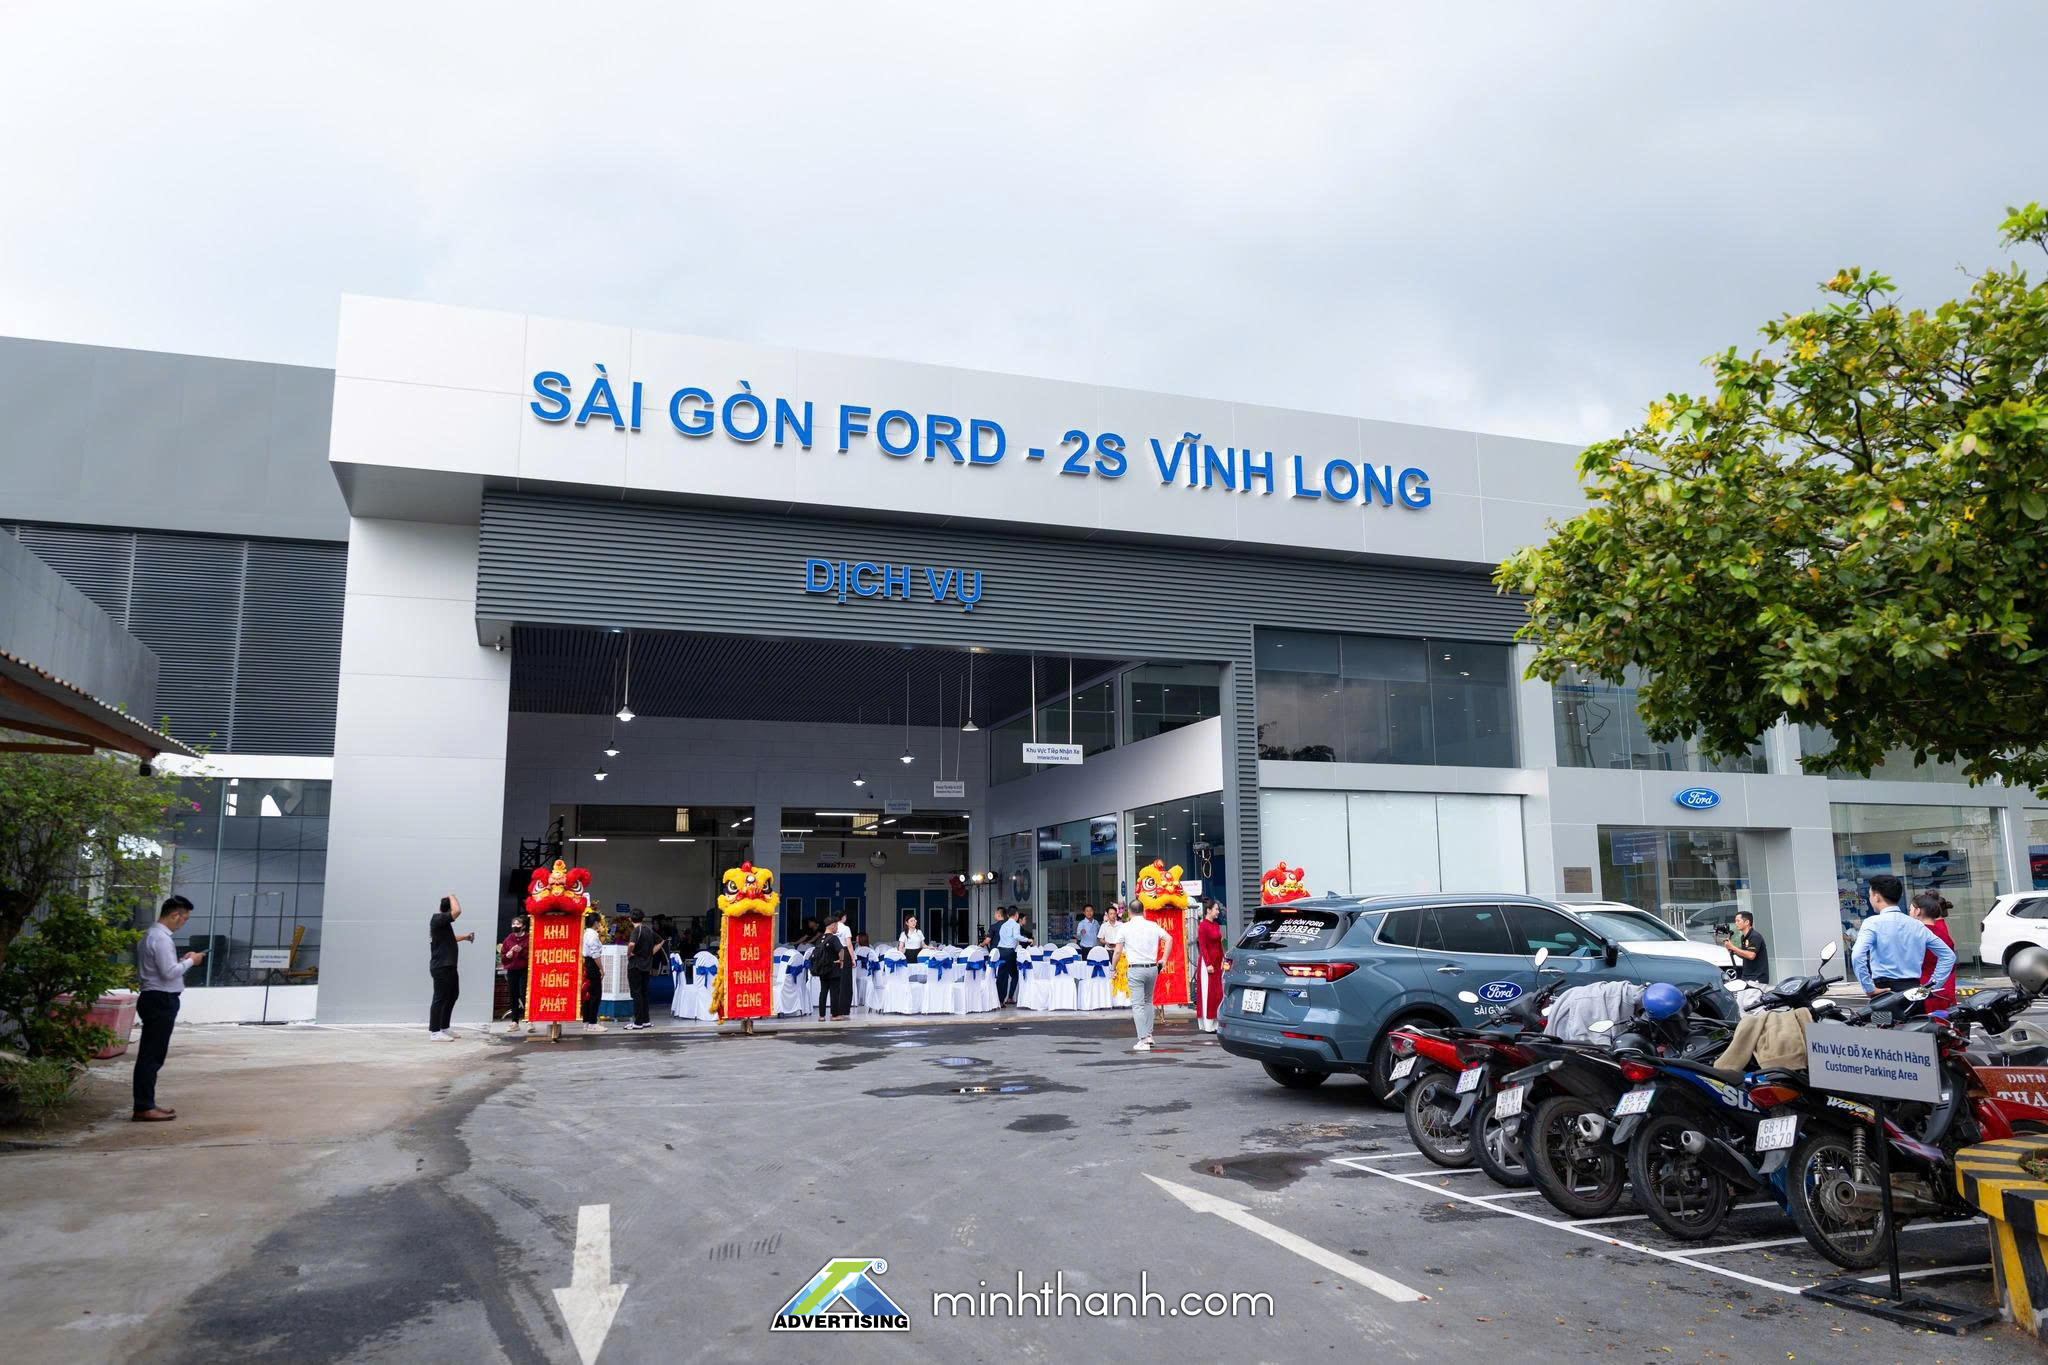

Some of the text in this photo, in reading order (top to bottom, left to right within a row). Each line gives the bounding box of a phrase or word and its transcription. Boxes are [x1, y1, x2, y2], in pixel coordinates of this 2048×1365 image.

[529, 363, 644, 431] SÀI
[669, 379, 813, 449] GÒN
[838, 403, 1006, 464] FORD
[1060, 429, 1128, 478] 2S
[1149, 432, 1274, 496] VĨNH
[1290, 454, 1432, 510] LONG
[805, 557, 982, 613] DỊCH VỤ
[543, 924, 569, 940] KHAI
[733, 966, 766, 985] THÀNH
[736, 989, 762, 1008] CÔNG
[1486, 984, 1514, 998] Ford
[540, 993, 567, 1012] PHÁT
[1474, 1003, 1488, 1015] SÀI
[1811, 1041, 1931, 1067] Khu Vực Đỗ Xe Khách Hàng
[1825, 1060, 1918, 1081] Customer Parking Area
[2006, 1073, 2047, 1083] DNTN
[1758, 1132, 1792, 1149] 095.70
